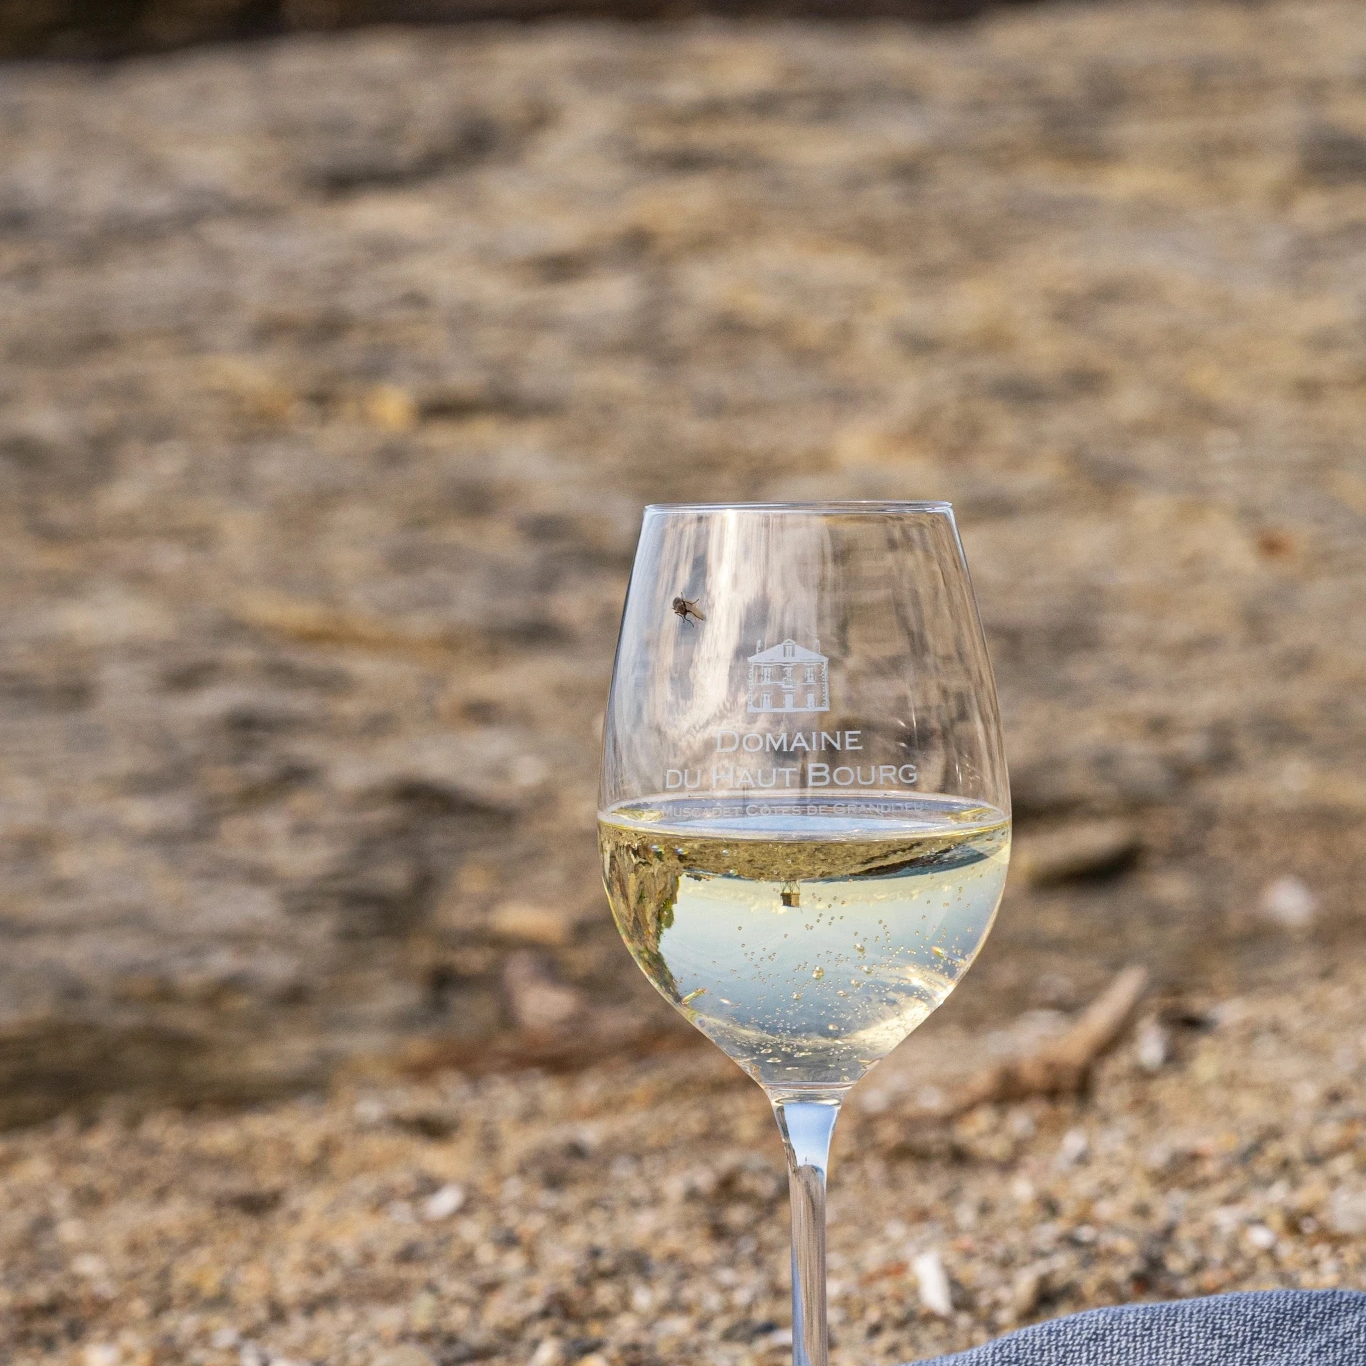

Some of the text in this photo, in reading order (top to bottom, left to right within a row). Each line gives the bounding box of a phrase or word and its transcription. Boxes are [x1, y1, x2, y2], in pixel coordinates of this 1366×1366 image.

[715, 730, 863, 753] DOMAINE
[664, 763, 918, 789] DU HAUT BOURG
[662, 804, 740, 818] MUSCADET
[745, 803, 802, 816] CÔTES
[806, 805, 828, 816] DE
